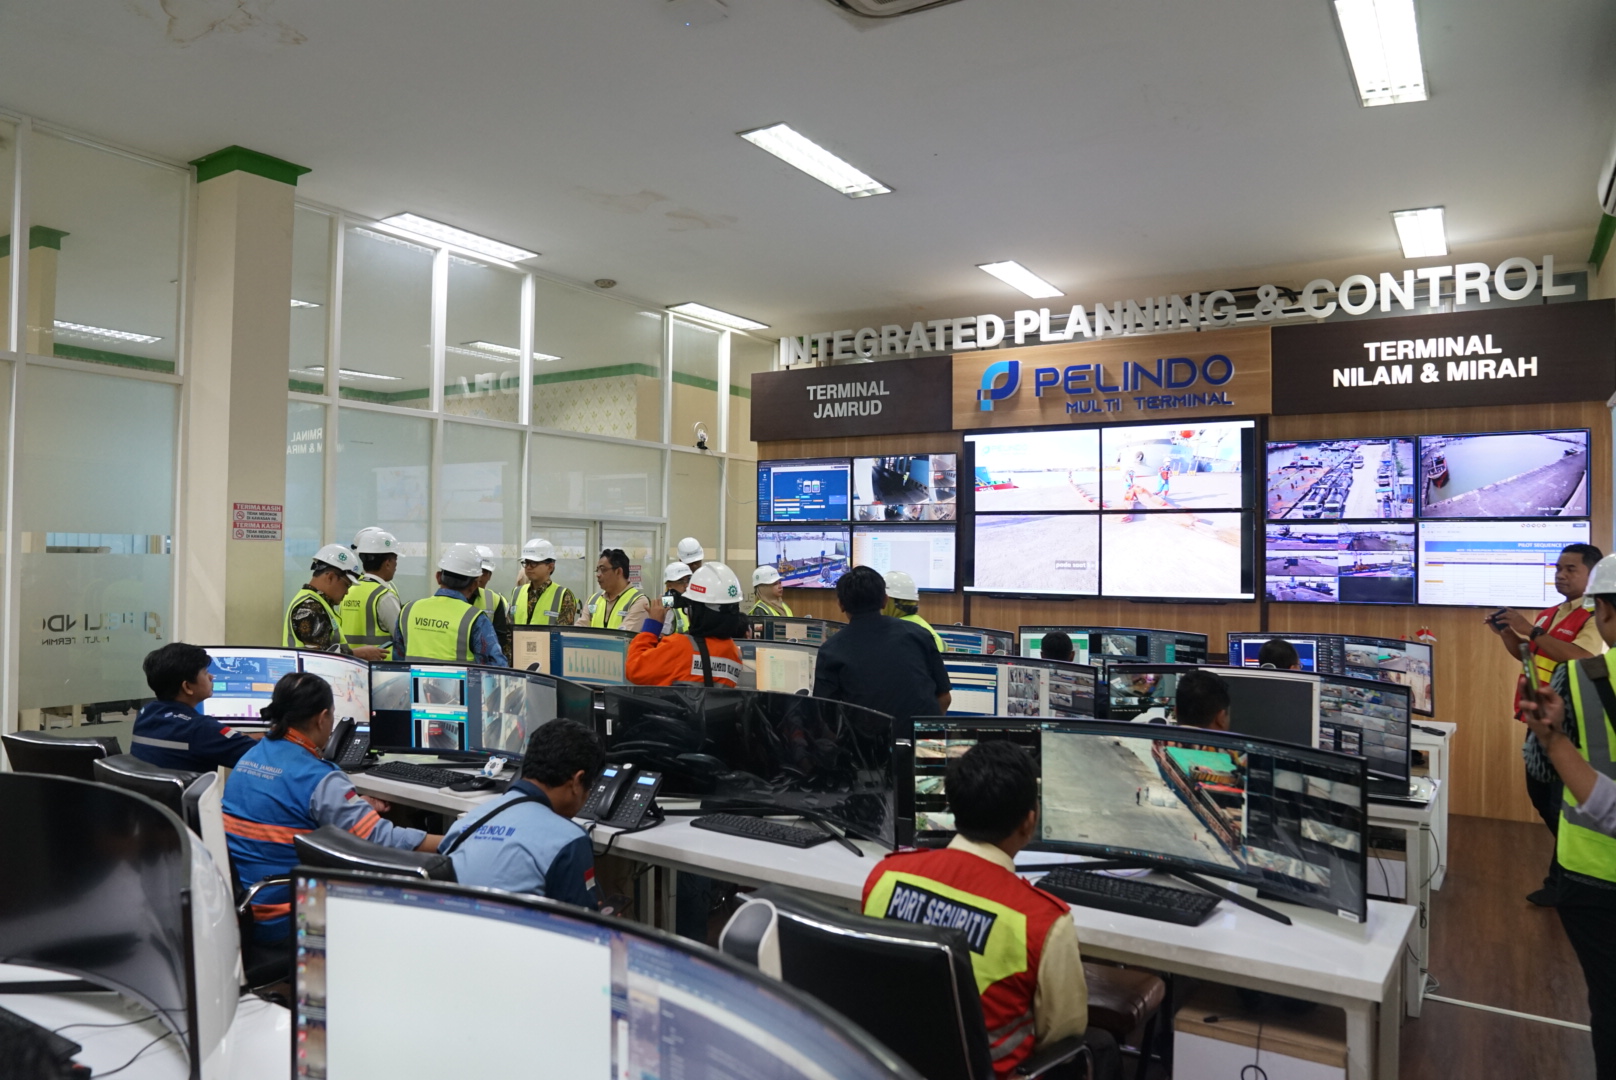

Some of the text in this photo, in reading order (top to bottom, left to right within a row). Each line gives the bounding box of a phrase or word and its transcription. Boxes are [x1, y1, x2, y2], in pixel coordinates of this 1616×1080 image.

[780, 255, 1576, 366] INTEGRATED PLANNING & CONTROL
[1364, 334, 1503, 362] TERMINAL
[1035, 354, 1235, 398] PELINDO
[1333, 356, 1538, 388] NILAM & MIRAH
[806, 380, 890, 401] TERMINAL
[813, 400, 882, 419] JAMRUD
[1066, 391, 1235, 414] MULTI TERMINAL
[236, 503, 261, 511] TERIMA
[344, 600, 361, 608] VISITOR
[415, 617, 450, 630] VISITOR
[260, 764, 283, 774] JAMRUD
[888, 886, 992, 948] PORT SECURITY
